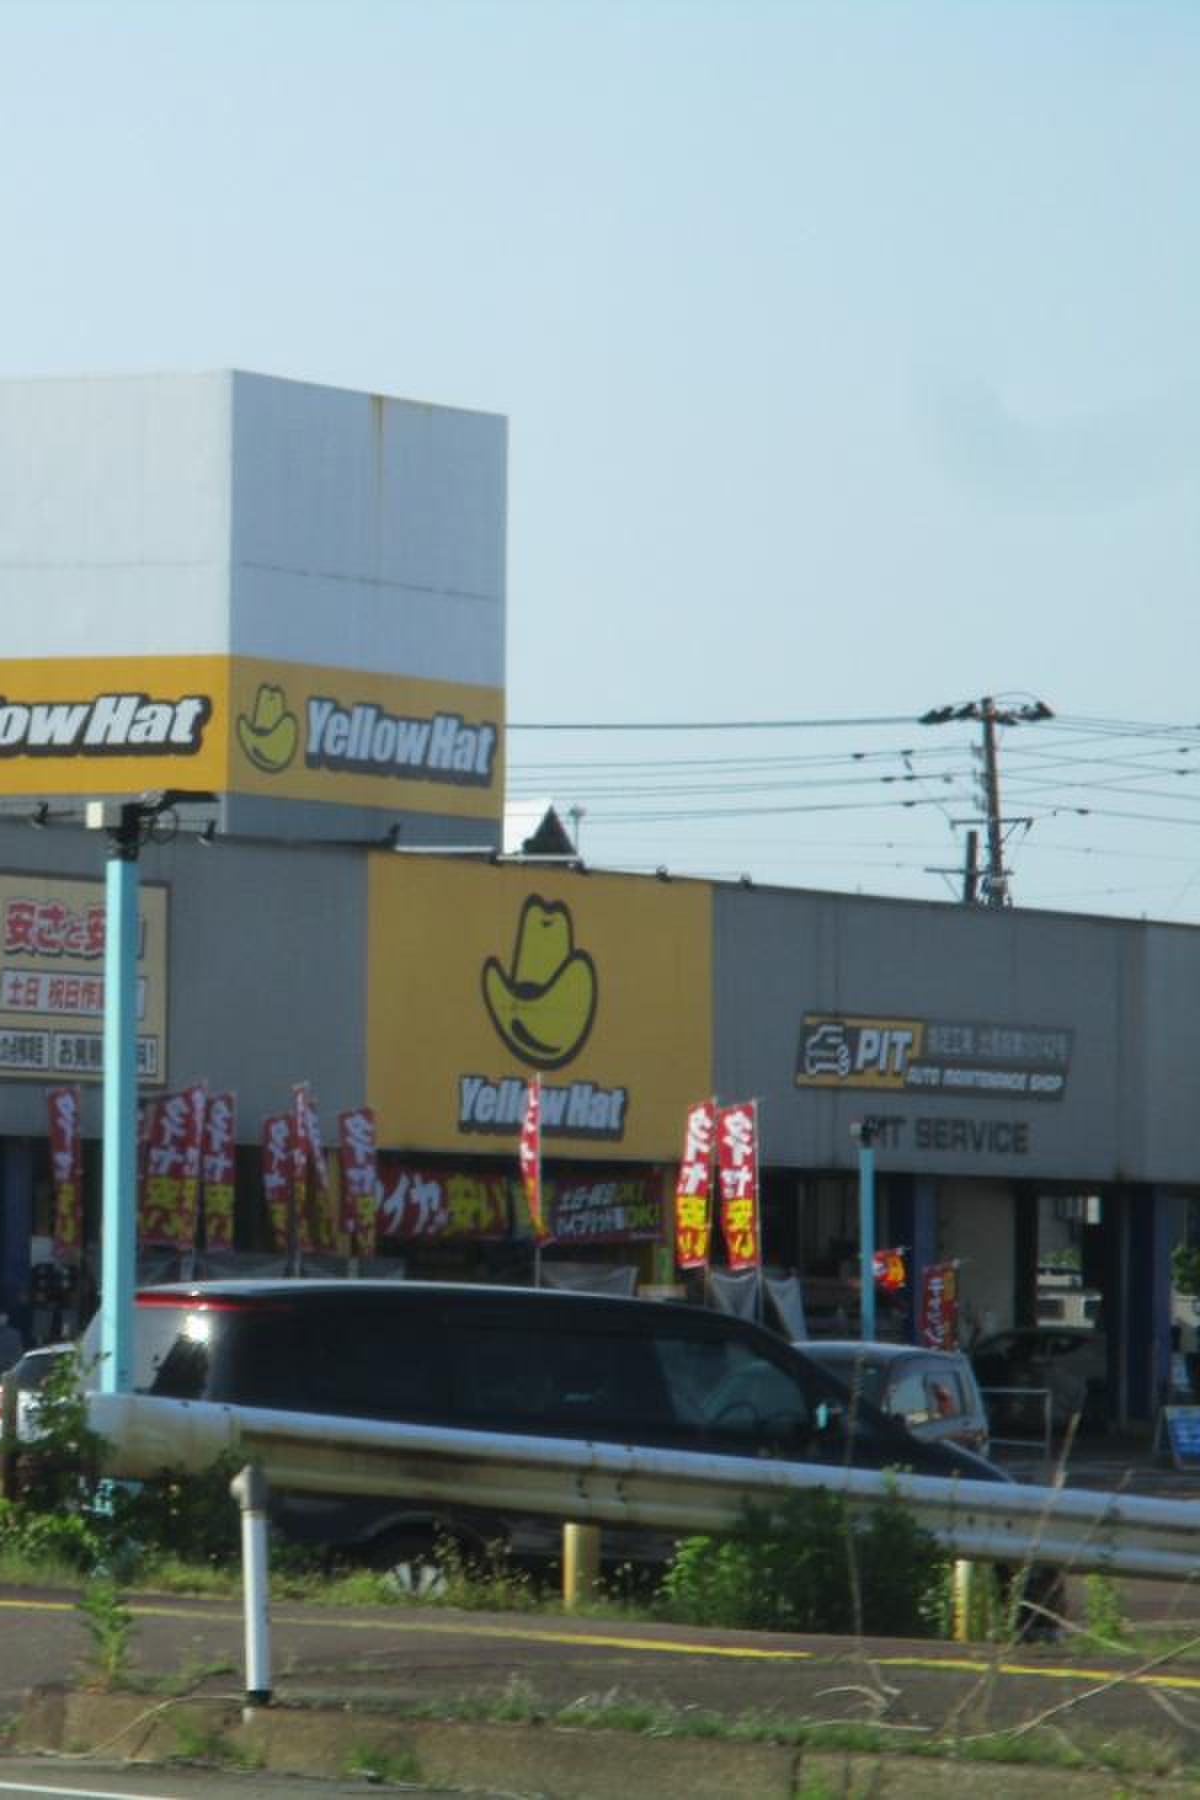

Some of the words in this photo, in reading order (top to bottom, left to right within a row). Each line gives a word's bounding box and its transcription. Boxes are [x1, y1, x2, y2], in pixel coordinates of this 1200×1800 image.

[4, 900, 107, 953] 安さと安
[854, 1028, 913, 1073] PIT
[914, 1118, 1030, 1155] SERVICE
